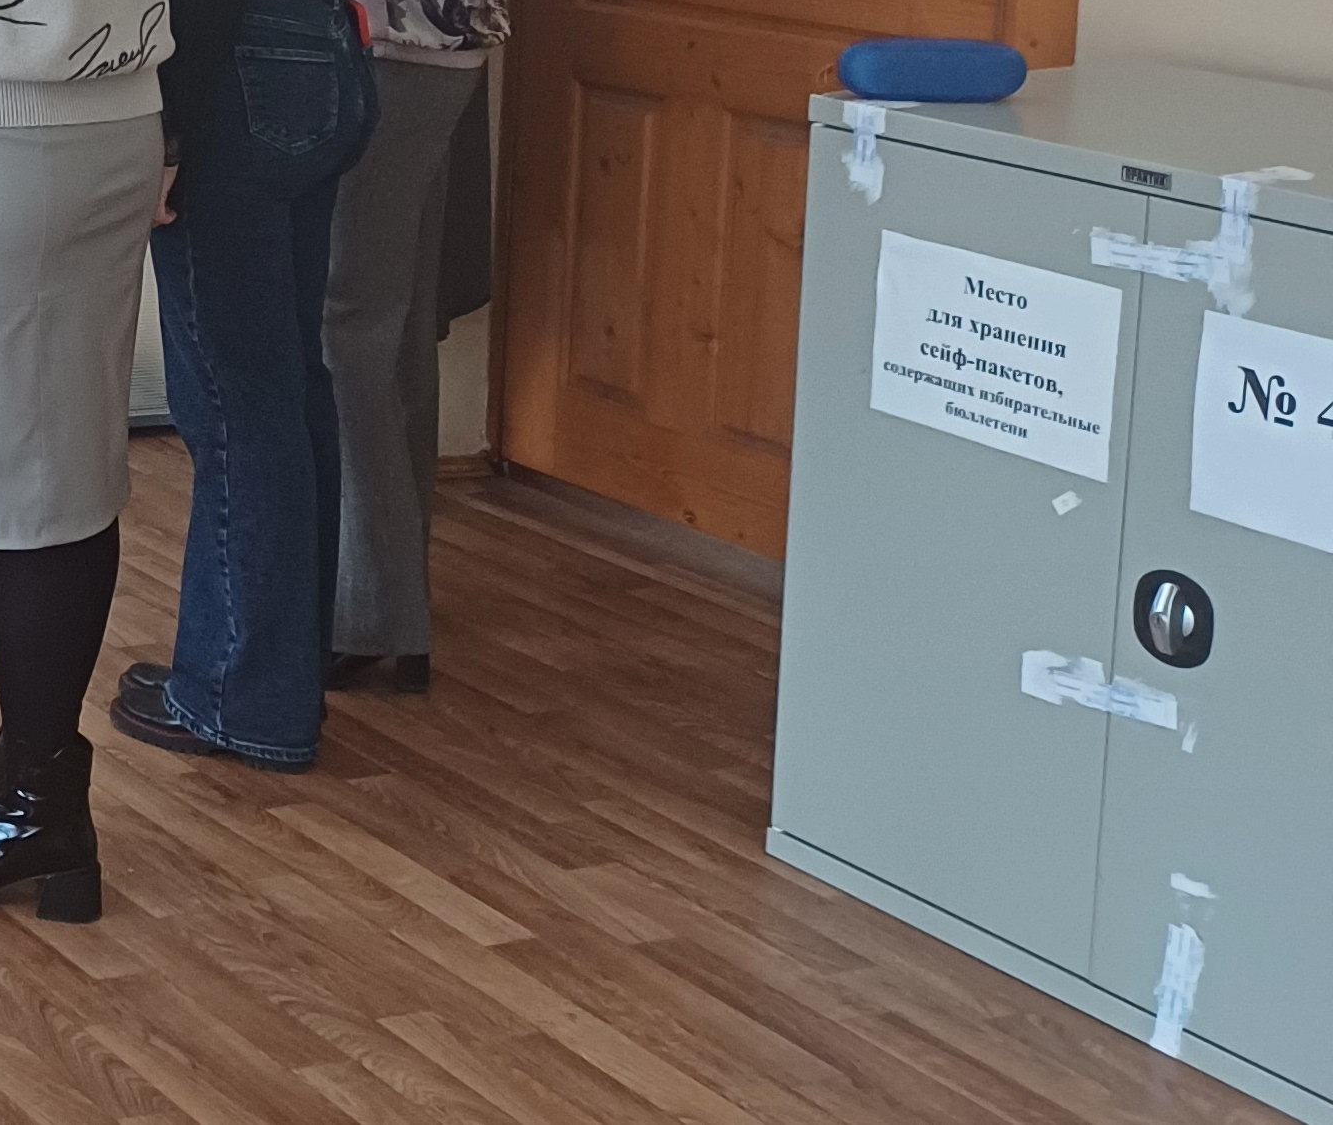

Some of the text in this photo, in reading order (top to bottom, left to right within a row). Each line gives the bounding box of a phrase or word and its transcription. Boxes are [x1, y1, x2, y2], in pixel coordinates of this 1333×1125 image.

[963, 275, 1028, 310] Место
[925, 308, 1067, 358] для хранения
[919, 341, 1064, 399] сейф-пакетов,
[883, 360, 1101, 435] содержащих избирательные
[945, 401, 1028, 439] бюллетени
